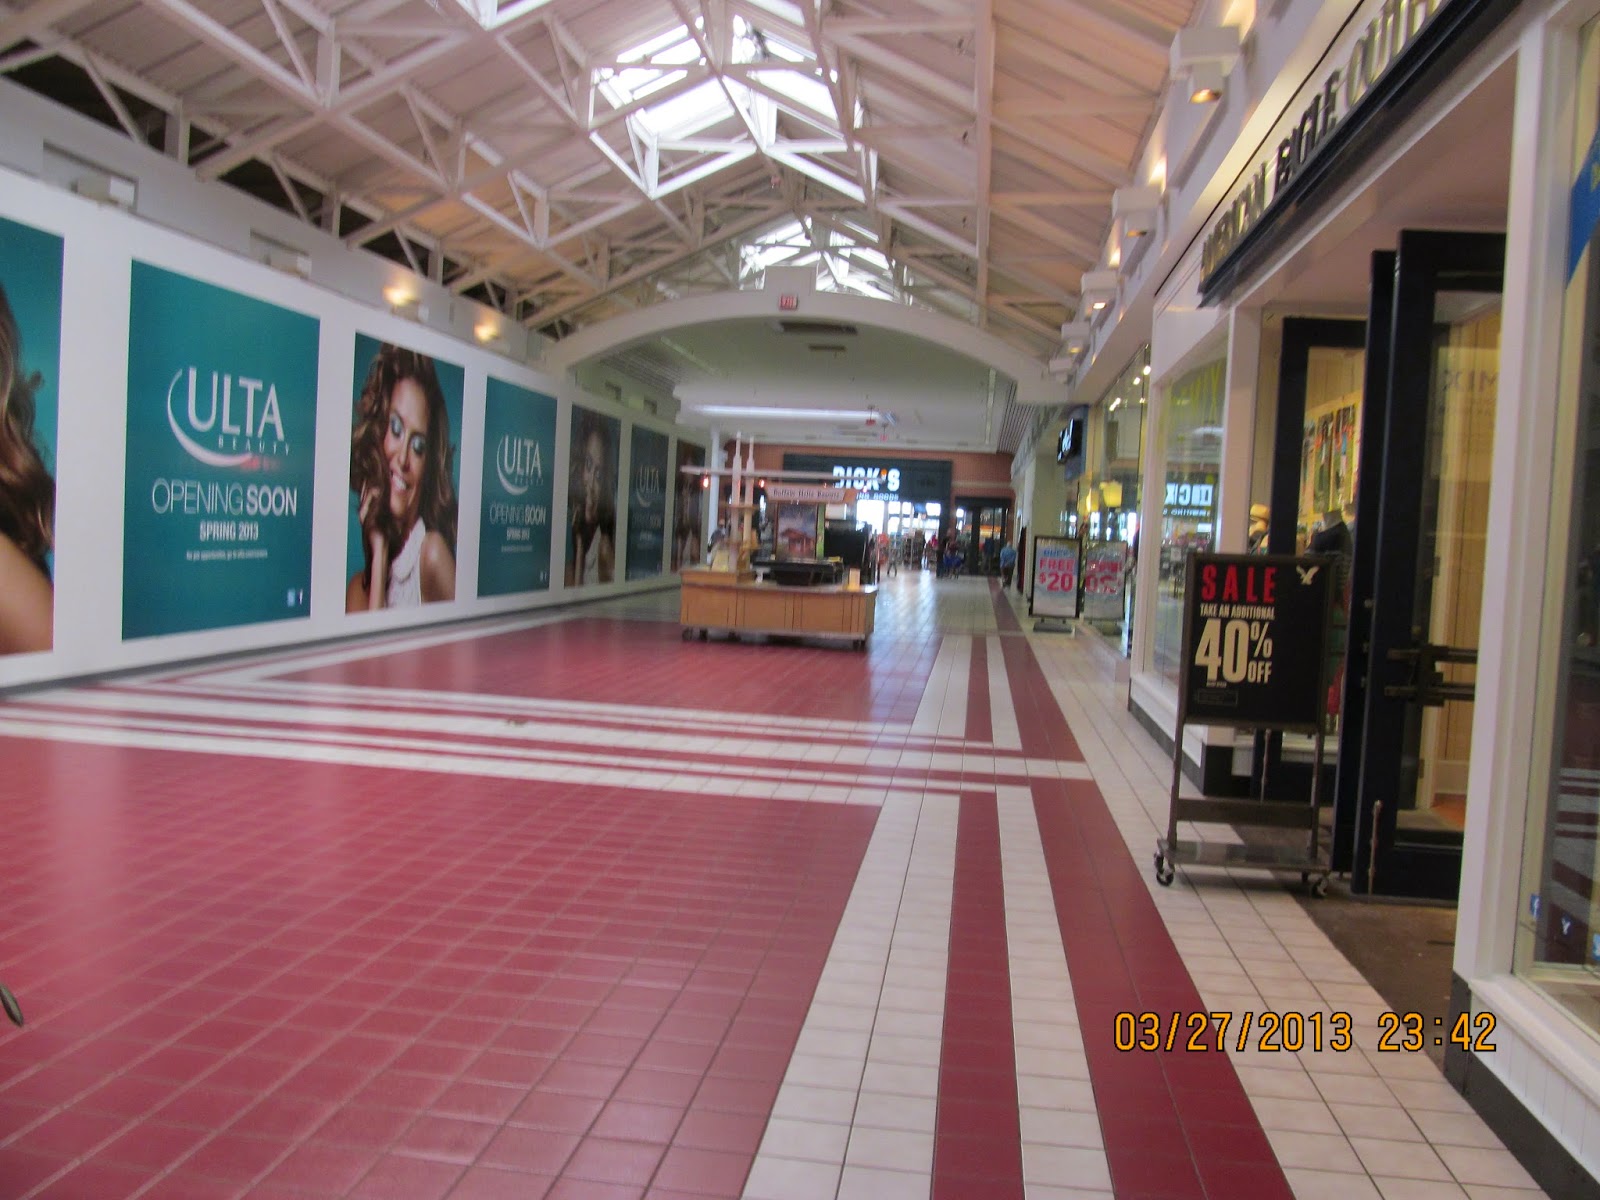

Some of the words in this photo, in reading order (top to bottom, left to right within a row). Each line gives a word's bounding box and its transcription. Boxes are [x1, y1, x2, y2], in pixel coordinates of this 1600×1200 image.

[188, 366, 284, 441] ULTA
[219, 434, 290, 456] BEAUTY
[504, 434, 542, 479] ULTA
[833, 465, 900, 491] DICK'S
[152, 477, 244, 516] OPENING
[245, 484, 298, 516] SOON
[200, 519, 236, 541] SPRING
[238, 520, 259, 541] 2013
[1039, 558, 1076, 571] FREE
[1039, 571, 1074, 592] $20
[1202, 563, 1277, 604] SALE
[1200, 602, 1218, 617] TAKE
[1218, 603, 1231, 618] AN
[1230, 604, 1276, 621] ADDITIONAL
[1194, 617, 1273, 683] 40%
[1247, 660, 1273, 684] OFF
